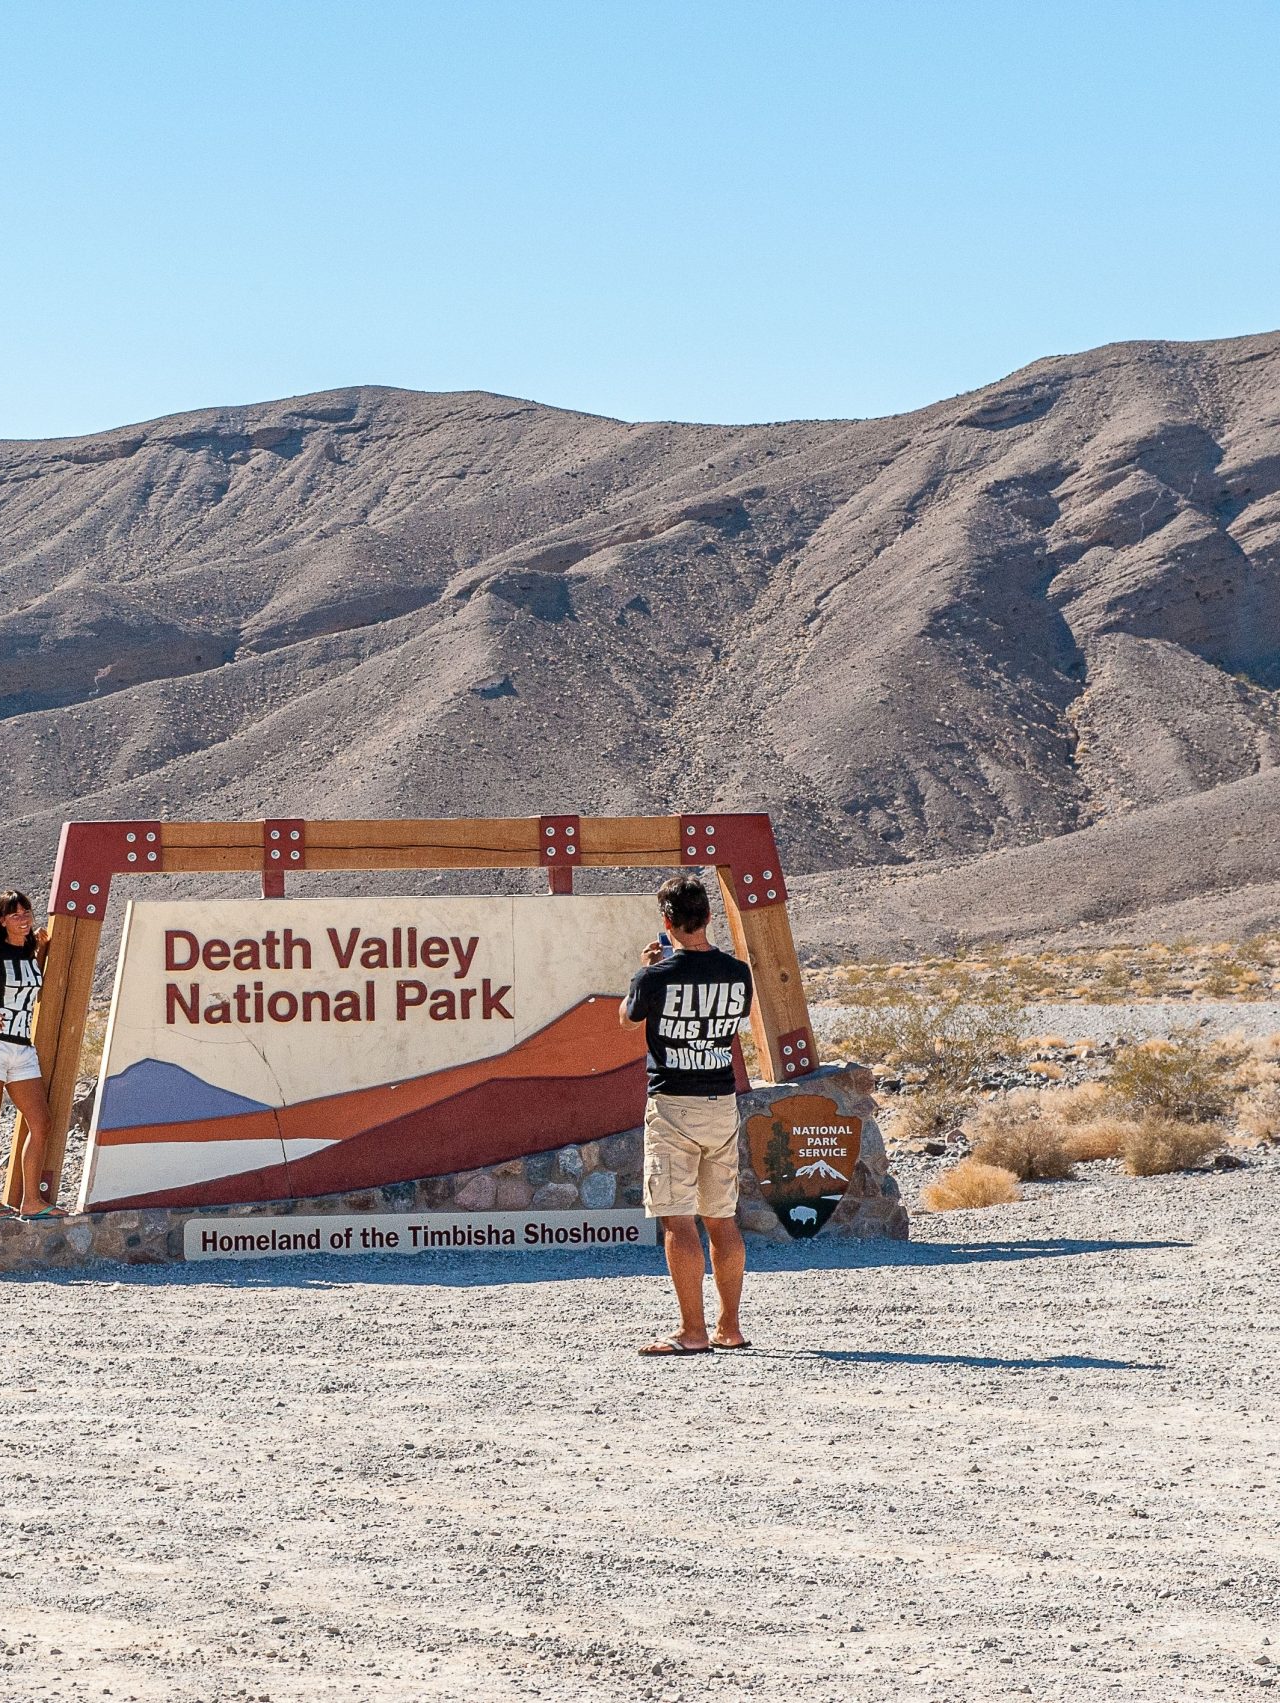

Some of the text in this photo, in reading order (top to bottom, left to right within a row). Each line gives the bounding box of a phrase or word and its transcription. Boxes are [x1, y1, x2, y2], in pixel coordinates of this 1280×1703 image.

[165, 927, 479, 979] Death Valley
[3, 958, 42, 987] LAS
[166, 979, 514, 1024] National Park
[662, 982, 745, 1017] ELVIS
[658, 1016, 740, 1039] HAS LEFT
[687, 1039, 715, 1050] THE
[792, 1126, 853, 1135] NATIONAL
[807, 1137, 838, 1146] PARK
[798, 1148, 847, 1157] SERVICE
[201, 1222, 640, 1251] Homeland of the Timbisha Shoshone
